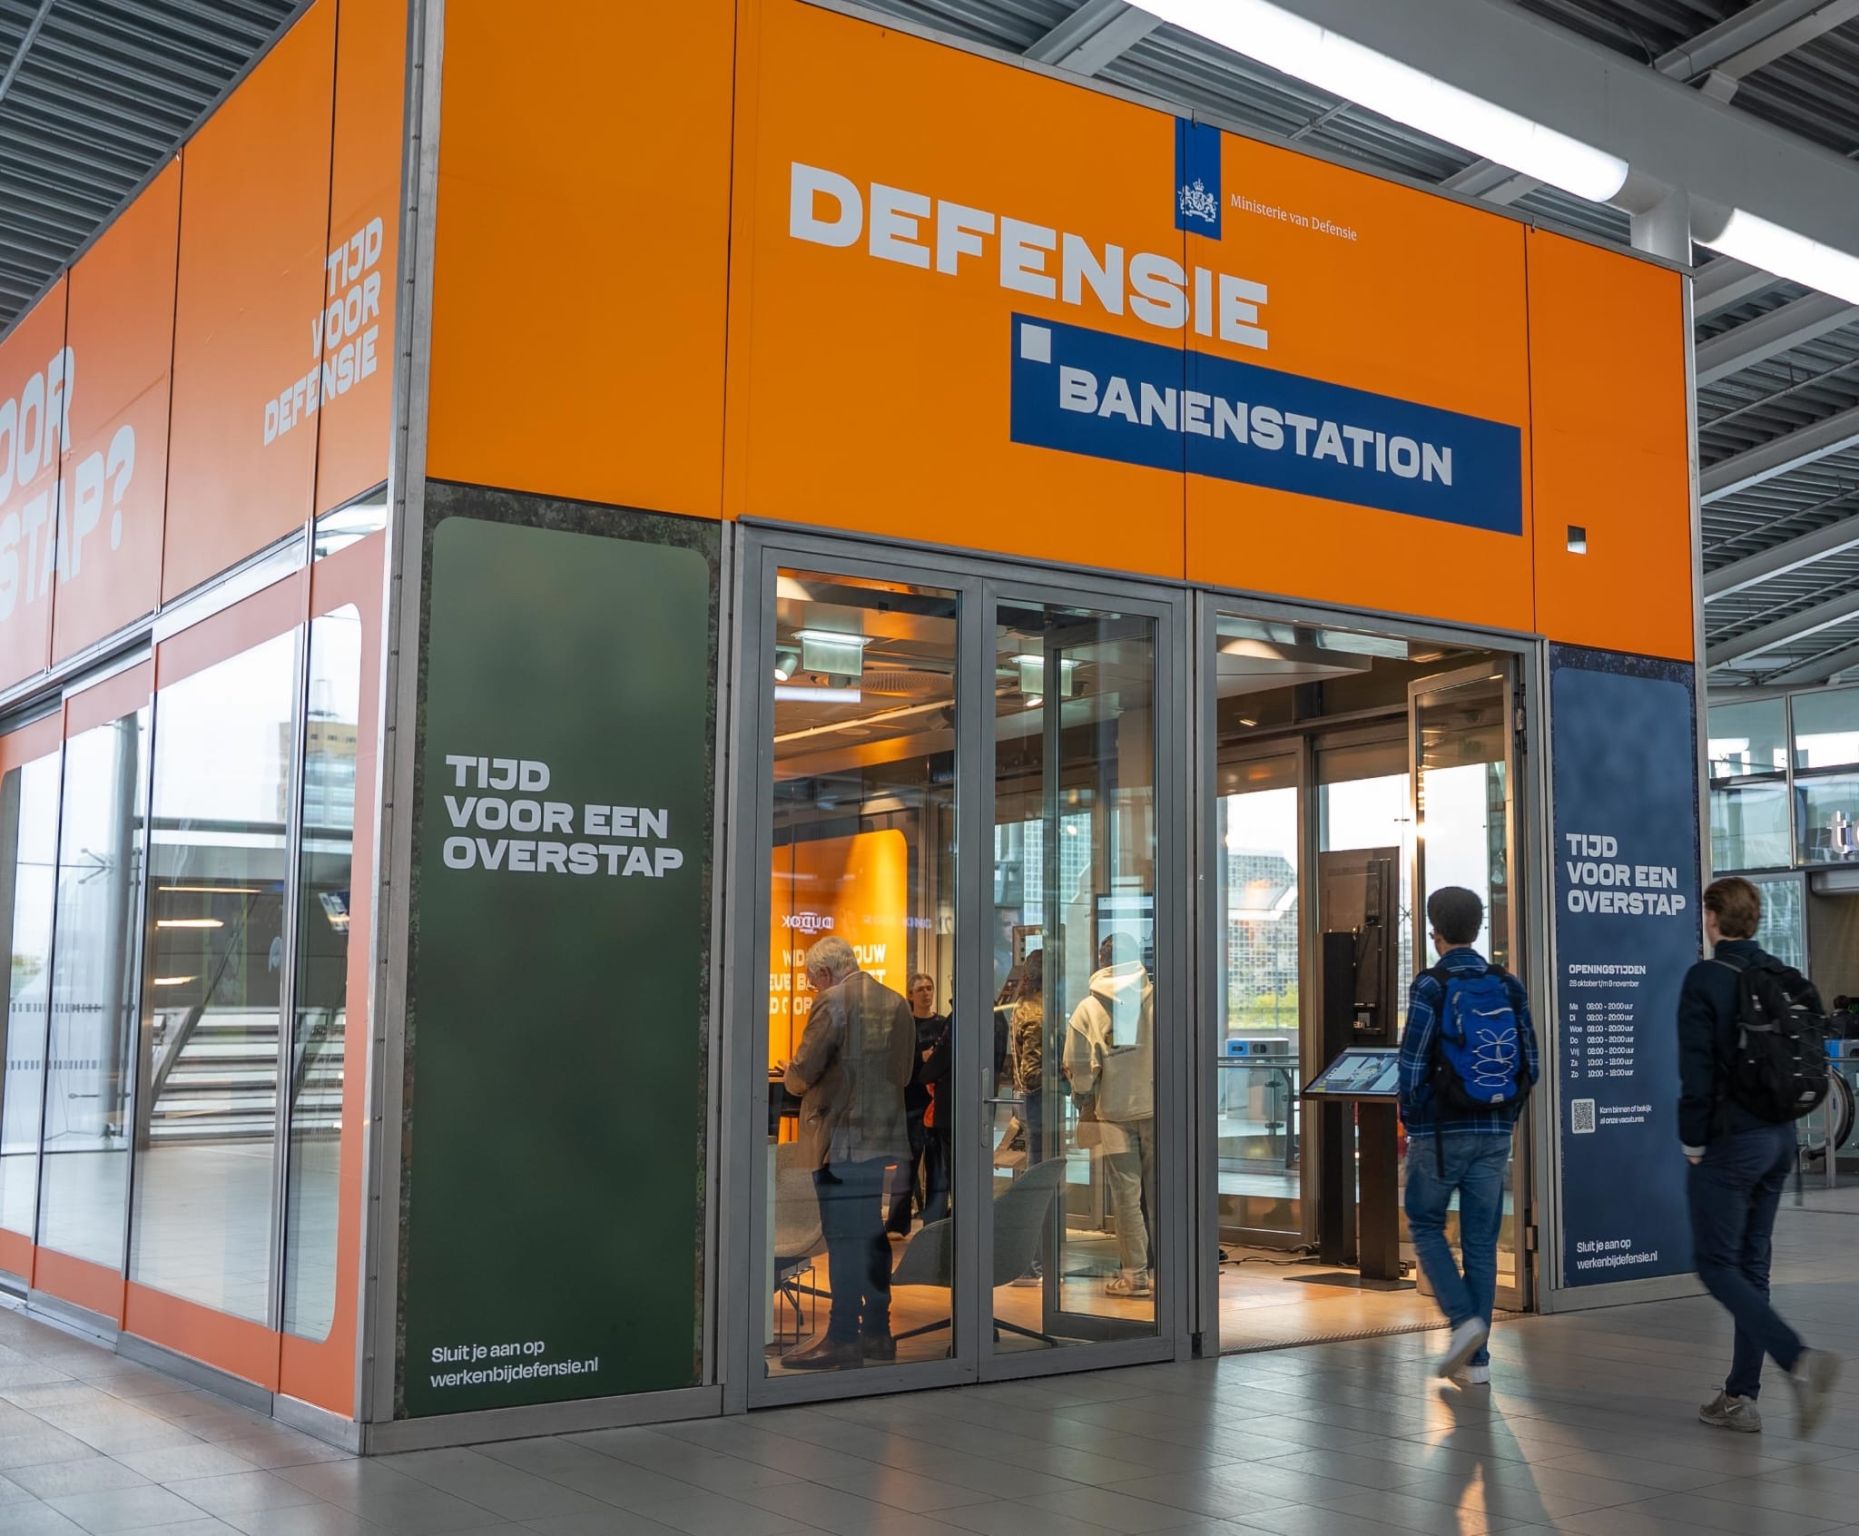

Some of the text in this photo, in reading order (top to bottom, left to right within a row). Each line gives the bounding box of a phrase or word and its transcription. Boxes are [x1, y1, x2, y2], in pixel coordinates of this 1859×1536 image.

[1230, 193, 1358, 241] Ministerie van Defensie
[325, 217, 383, 297] TIJD
[789, 161, 1269, 351] DEFENSIE
[312, 271, 381, 359] VOOR
[264, 325, 379, 447] DEFENSIE
[1059, 365, 1453, 486] BANENSTATION
[446, 754, 550, 792] TIJD
[443, 795, 668, 839] VOOR EEN
[443, 836, 684, 877] OVERSTAP
[1566, 833, 1618, 858] TIJD
[1566, 861, 1677, 889] VOOR EEN
[1567, 889, 1686, 915] OVERSTAP
[1568, 964, 1646, 975] OPENINGSTIJDEN
[1577, 980, 1598, 988] oktober
[1613, 980, 1639, 988] november
[1576, 1239, 1631, 1253] Sluit je aan op
[1576, 1250, 1658, 1269] werkenbijdefensie.nl
[431, 1341, 545, 1363] Sluit je aan op
[430, 1357, 599, 1388] werkenbijdefensie.nl
